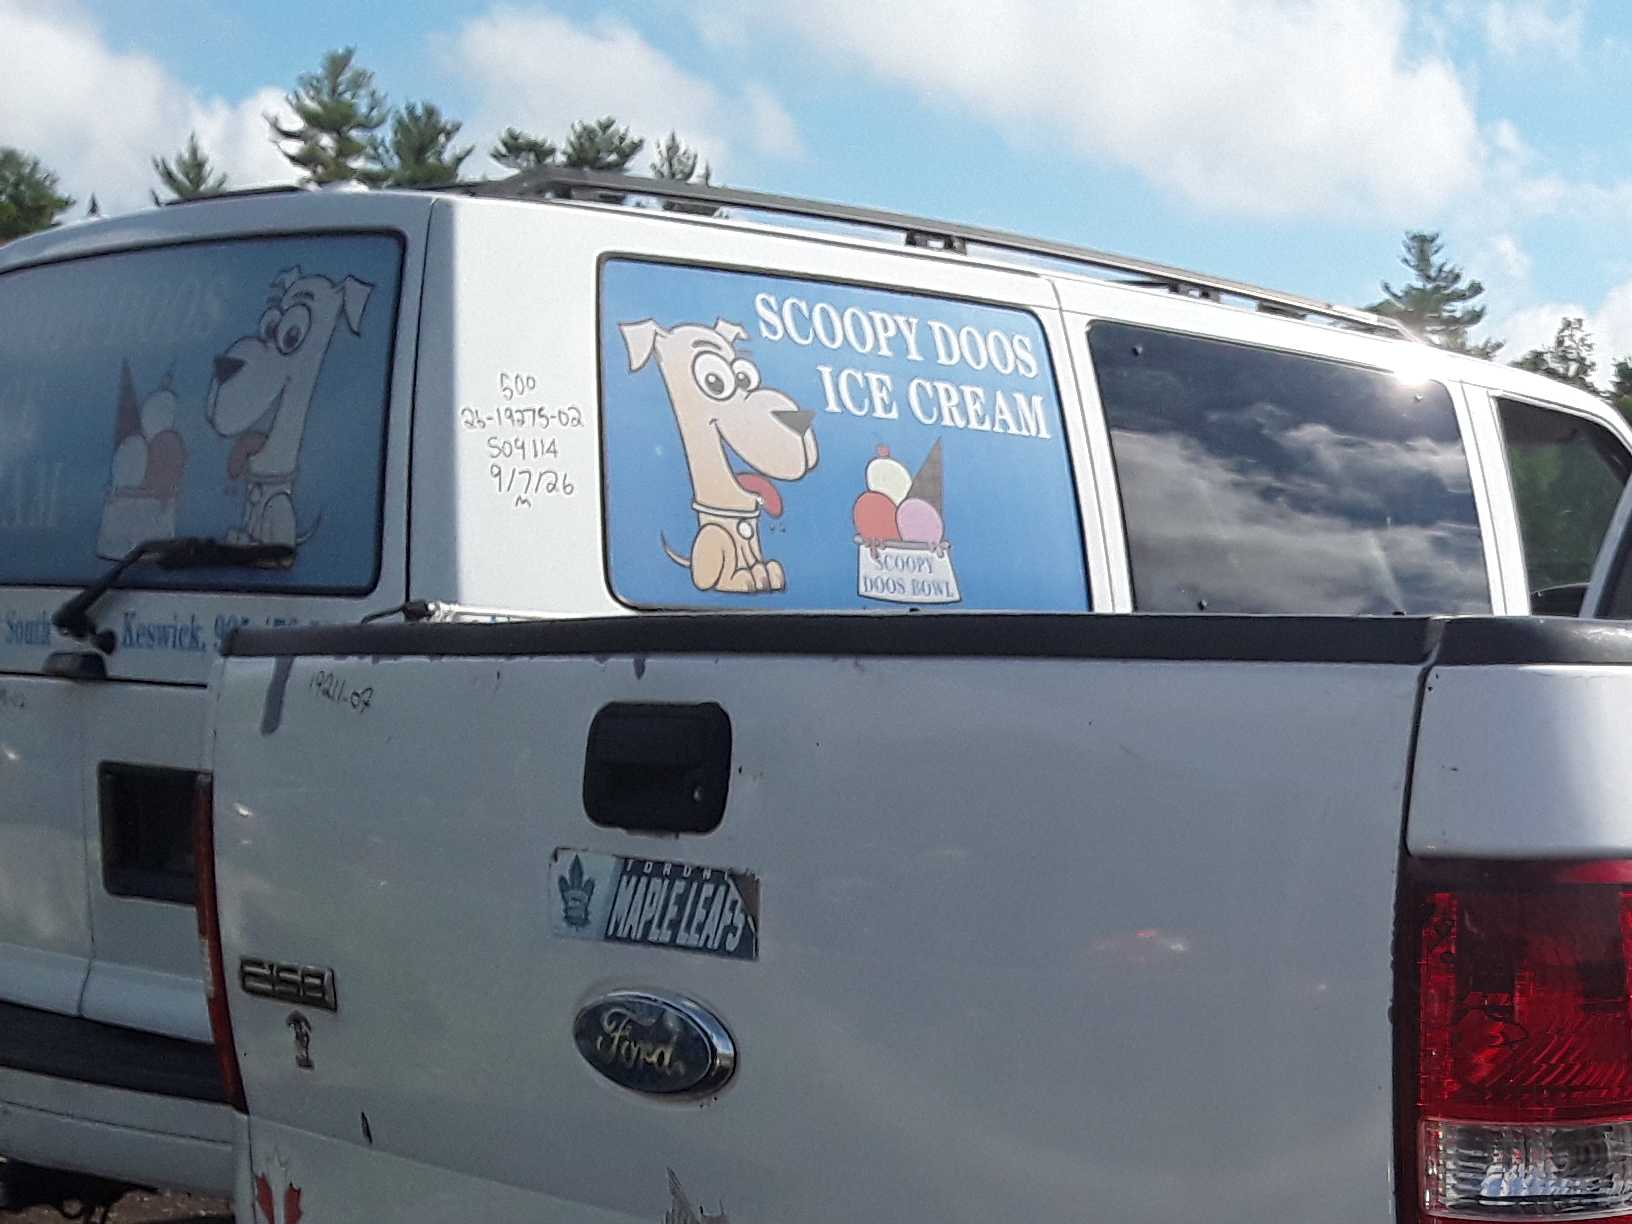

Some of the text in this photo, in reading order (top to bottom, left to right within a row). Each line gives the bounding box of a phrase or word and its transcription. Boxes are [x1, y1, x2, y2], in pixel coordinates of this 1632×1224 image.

[754, 292, 1038, 378] SCOOPY DOOS
[500, 372, 536, 401] 500
[817, 365, 1051, 440] ICE CREAM
[863, 575, 953, 598] DOOS BOWL
[875, 554, 932, 574] SCOOPY
[625, 858, 729, 881] TORON
[607, 874, 746, 952] MAPLE LEAFS
[596, 1008, 686, 1077] Ford
